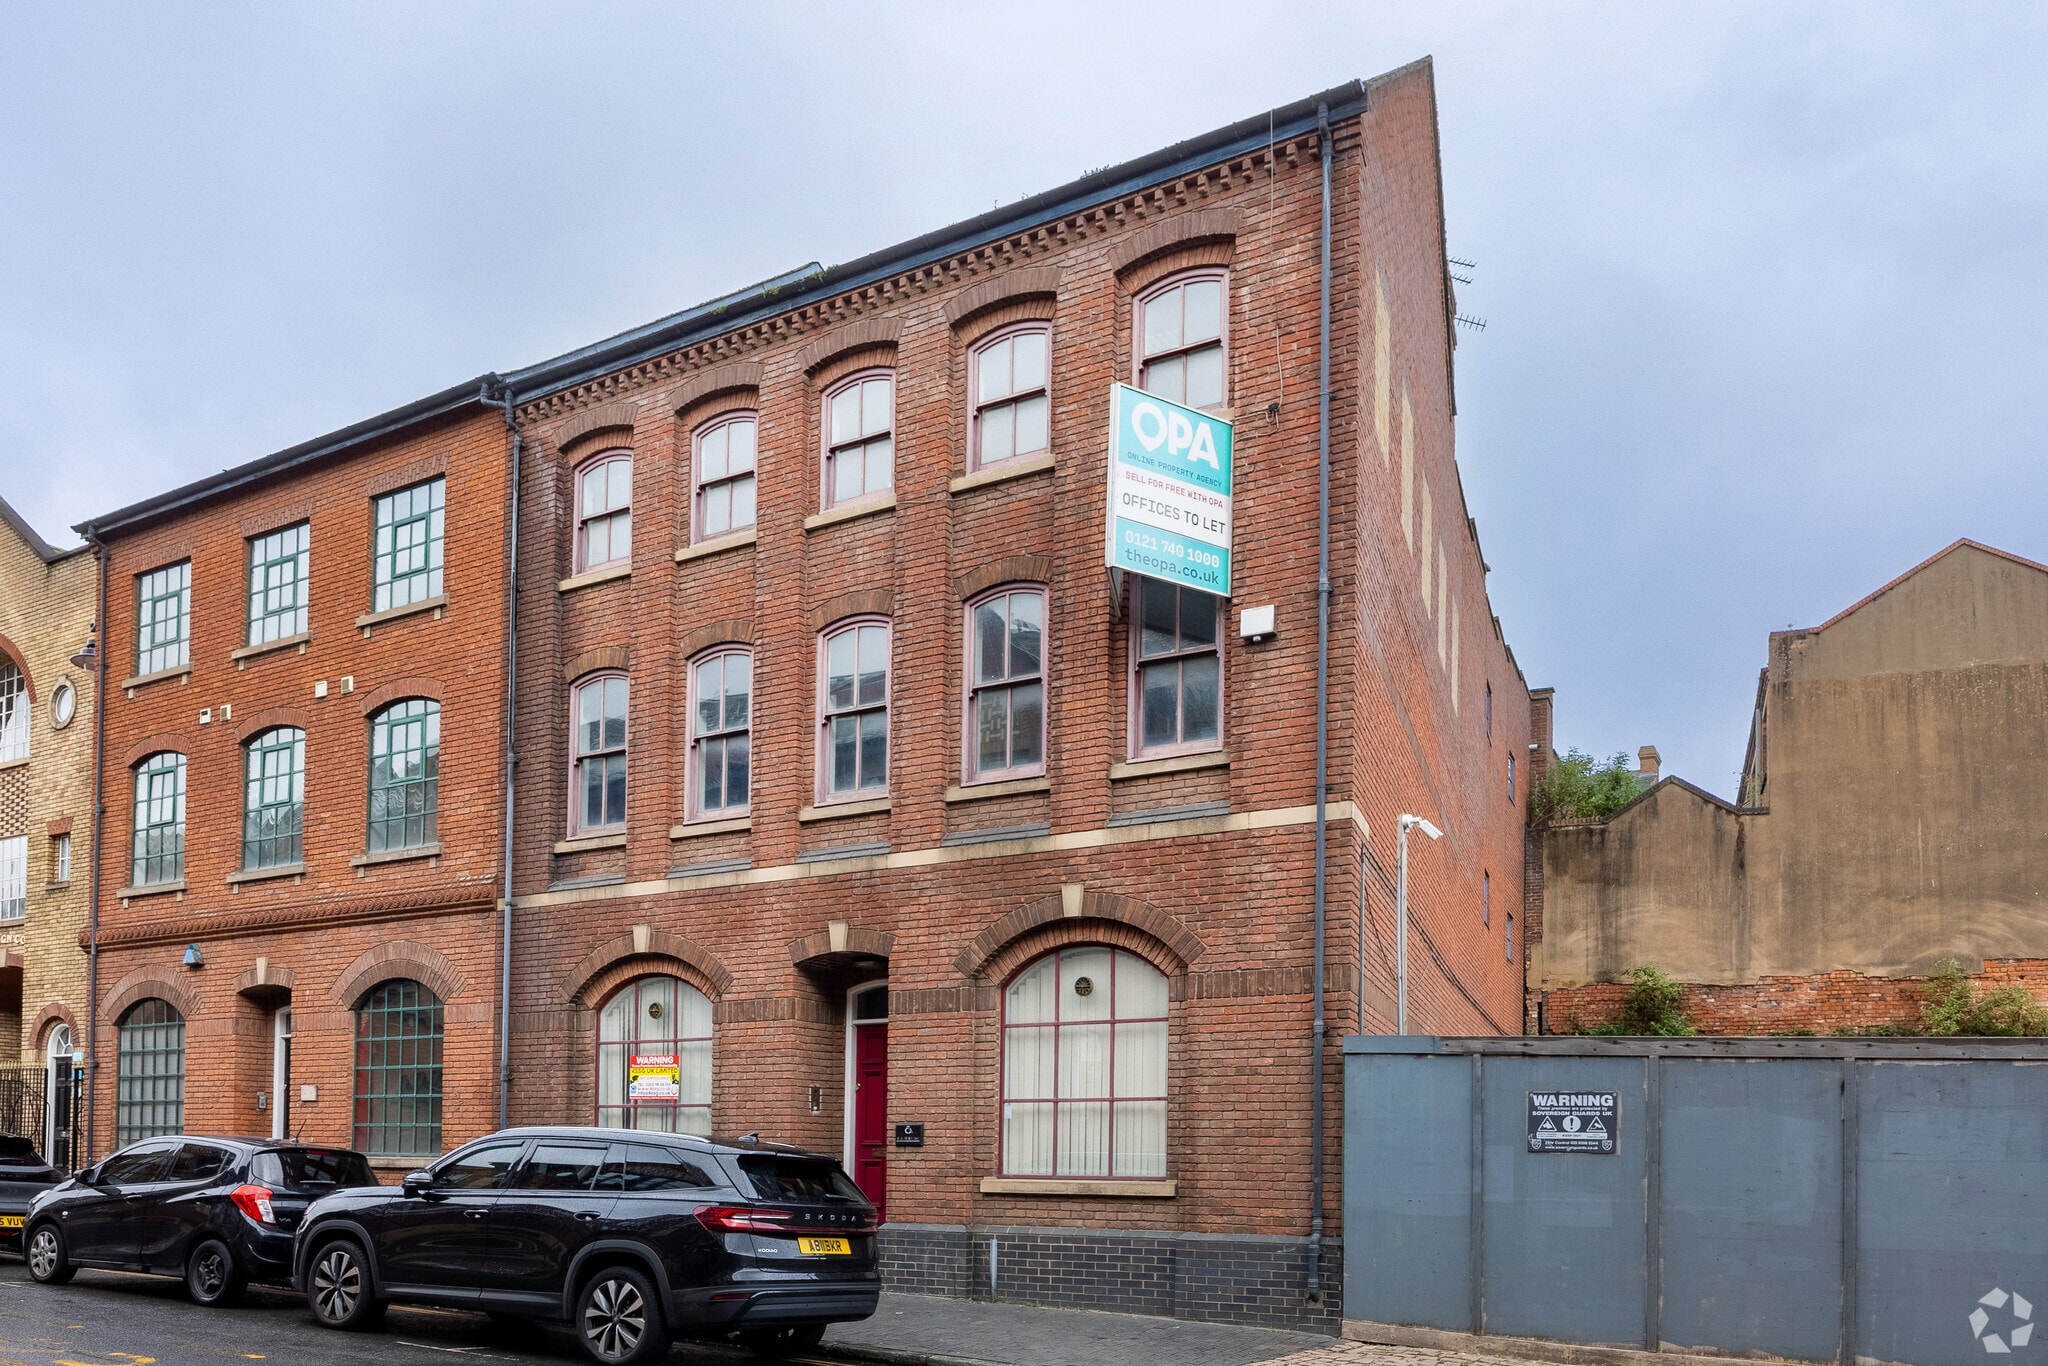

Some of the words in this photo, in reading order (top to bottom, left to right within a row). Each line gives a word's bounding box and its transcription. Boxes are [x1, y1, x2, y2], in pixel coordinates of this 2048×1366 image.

[1131, 401, 1220, 470] OPA
[1127, 451, 1155, 467] ONLINE
[1157, 461, 1194, 480] PROPERTY
[1196, 473, 1223, 488] AGENCY
[1125, 470, 1146, 485] SELL
[1147, 477, 1164, 490] FOR
[1165, 483, 1185, 496] FREE
[1187, 490, 1207, 503] WITH
[1208, 497, 1223, 509] OPA
[1122, 492, 1180, 520] OFFICES
[1184, 510, 1199, 526] TO
[1203, 517, 1226, 535] LET
[1124, 547, 1220, 585] theopa.co.uk
[1125, 529, 1157, 551] 0121
[1161, 541, 1184, 558] 740
[1187, 549, 1220, 568] 1000
[1533, 1094, 1614, 1107] WARNING
[804, 1213, 856, 1222] SKODA
